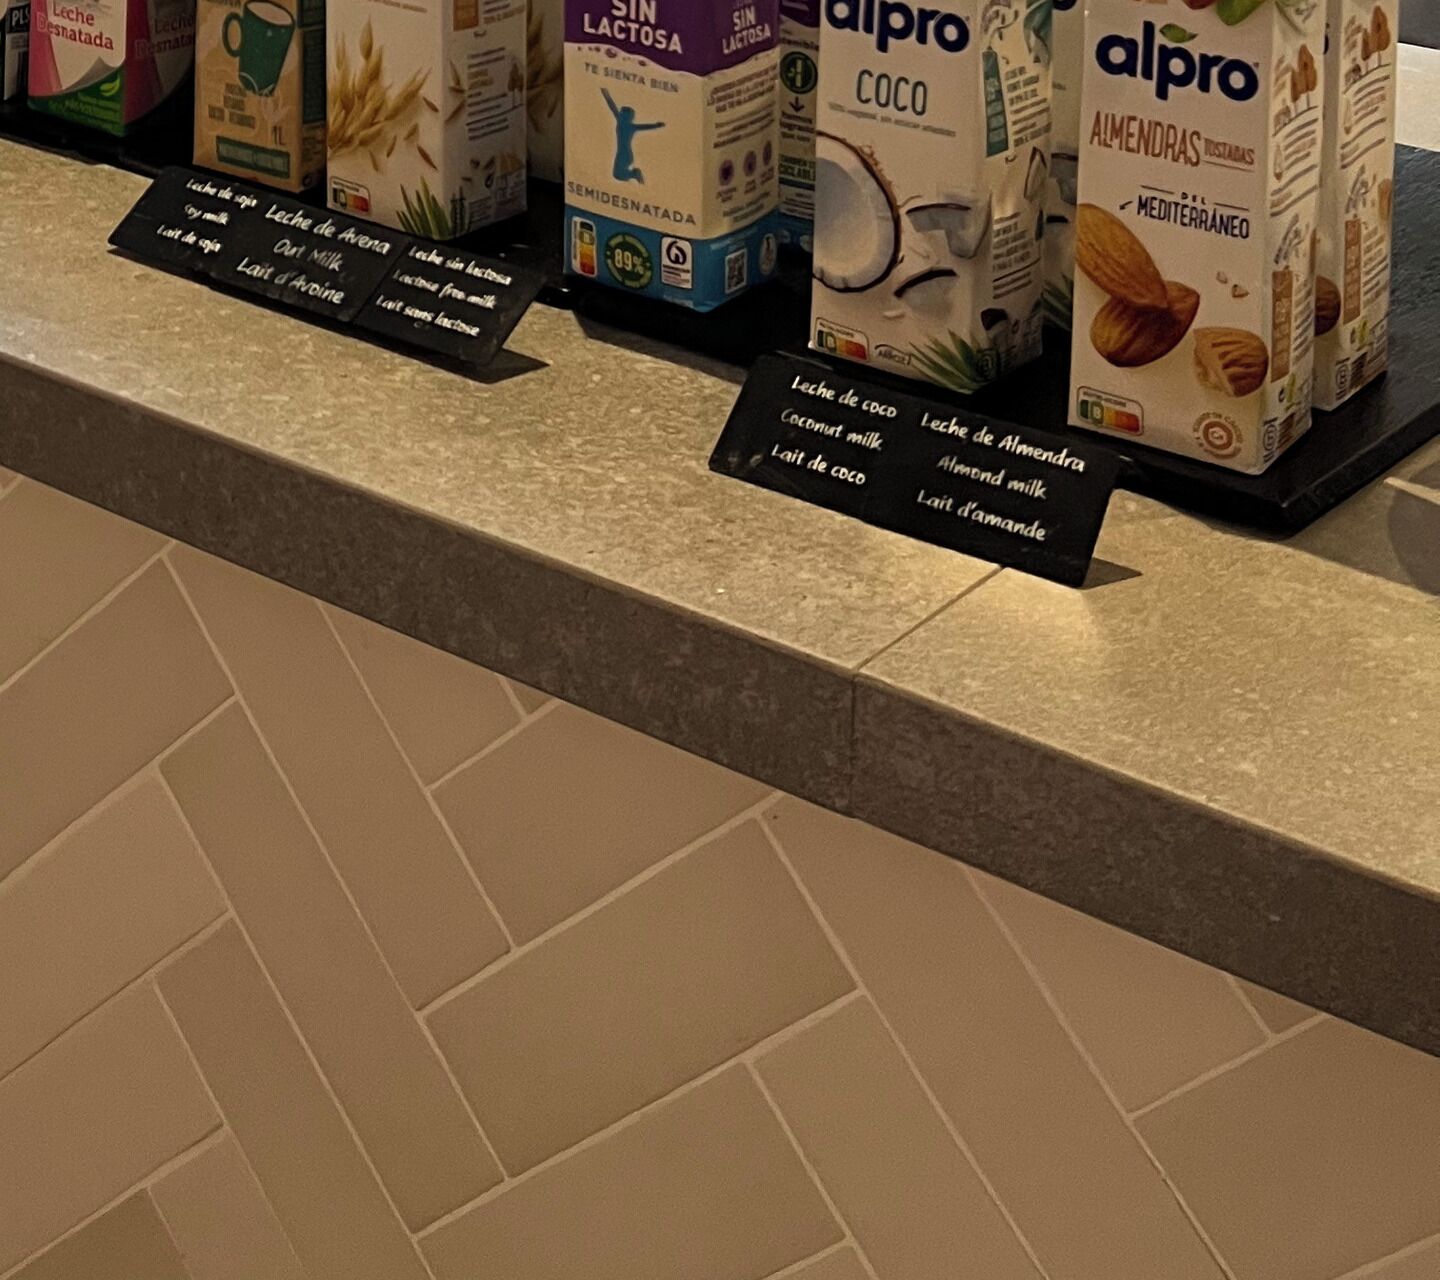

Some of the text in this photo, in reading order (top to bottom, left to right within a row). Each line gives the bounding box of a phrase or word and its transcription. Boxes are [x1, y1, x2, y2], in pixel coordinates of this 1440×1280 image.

[36, 11, 114, 51] Desnatada
[53, 1, 95, 27] Leche
[583, 12, 683, 55] LACTOSA
[733, 5, 756, 32] SIN
[722, 23, 772, 55] LACTOSA
[584, 61, 679, 93] TE SIENTA BIEN
[1095, 20, 1258, 102] alpro
[856, 67, 928, 117] COCO
[1089, 110, 1201, 167] ALMENDRAS
[1203, 137, 1255, 166] TOSTADAS
[186, 178, 218, 196] Leche
[218, 186, 233, 200] de
[567, 181, 697, 226] SEMIDESNATADA
[1181, 192, 1207, 206] DEL
[157, 224, 182, 240] Lait
[181, 231, 197, 245] de
[265, 204, 392, 256] Leche de Avena
[1137, 194, 1250, 240] MEDITERRÁNEO
[237, 256, 275, 280] Lait
[408, 245, 444, 266] Leche
[445, 257, 465, 271] sin
[613, 248, 645, 275] 89%
[376, 294, 404, 312] Lait
[791, 375, 897, 418] Leche de coco
[781, 408, 884, 451] Coconut milk
[920, 412, 1087, 473] Leche de Almendra
[771, 443, 866, 485] Lait de coco
[936, 455, 1048, 500] Almond milk
[916, 489, 1047, 541] Lait d'amande
